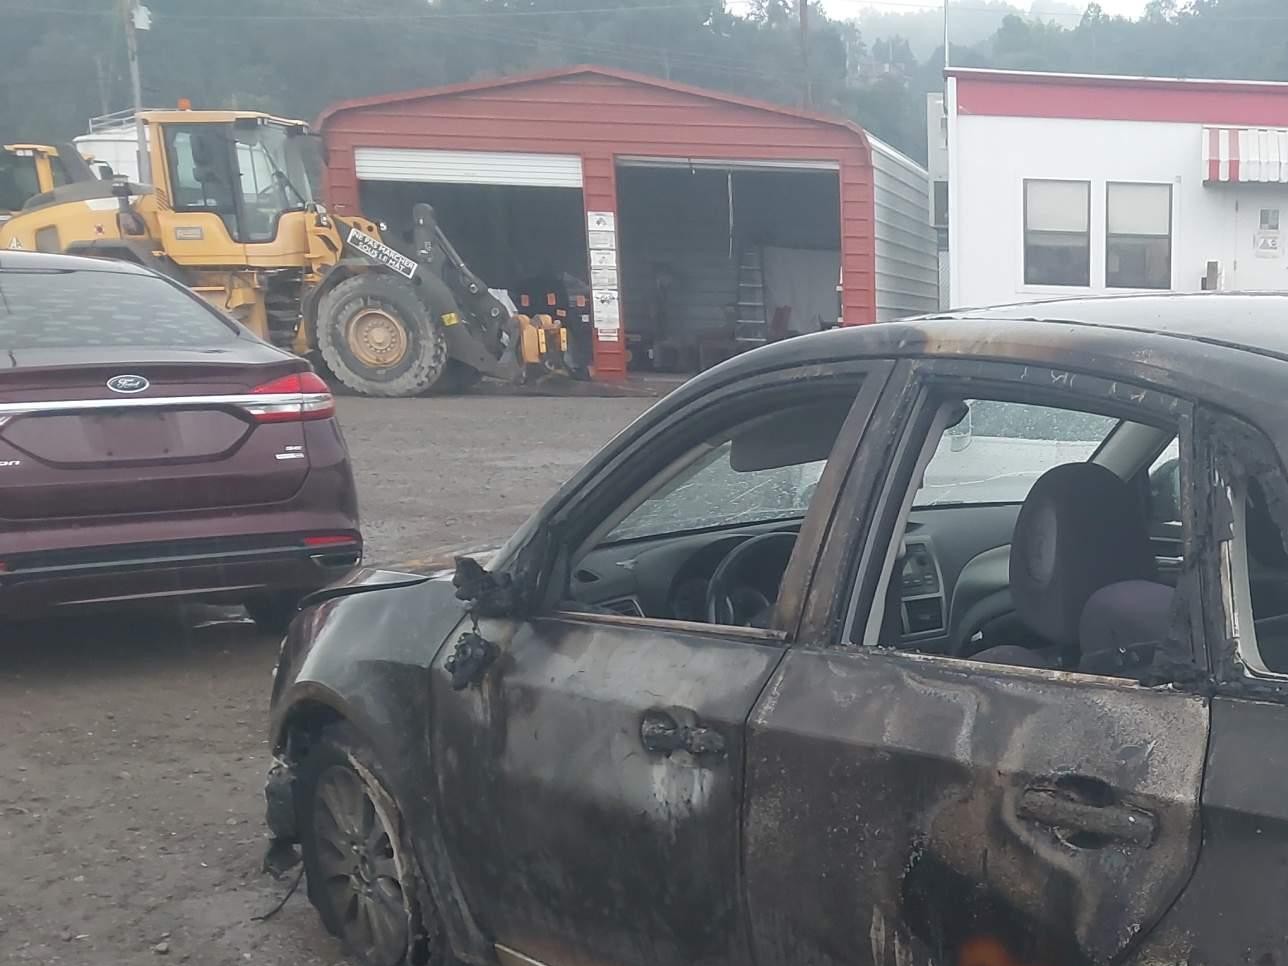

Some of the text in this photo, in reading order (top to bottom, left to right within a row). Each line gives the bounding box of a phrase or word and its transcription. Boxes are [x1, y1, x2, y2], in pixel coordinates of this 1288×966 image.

[359, 241, 378, 258] SOUS
[364, 236, 378, 249] PAS
[378, 243, 415, 269] MARCHER
